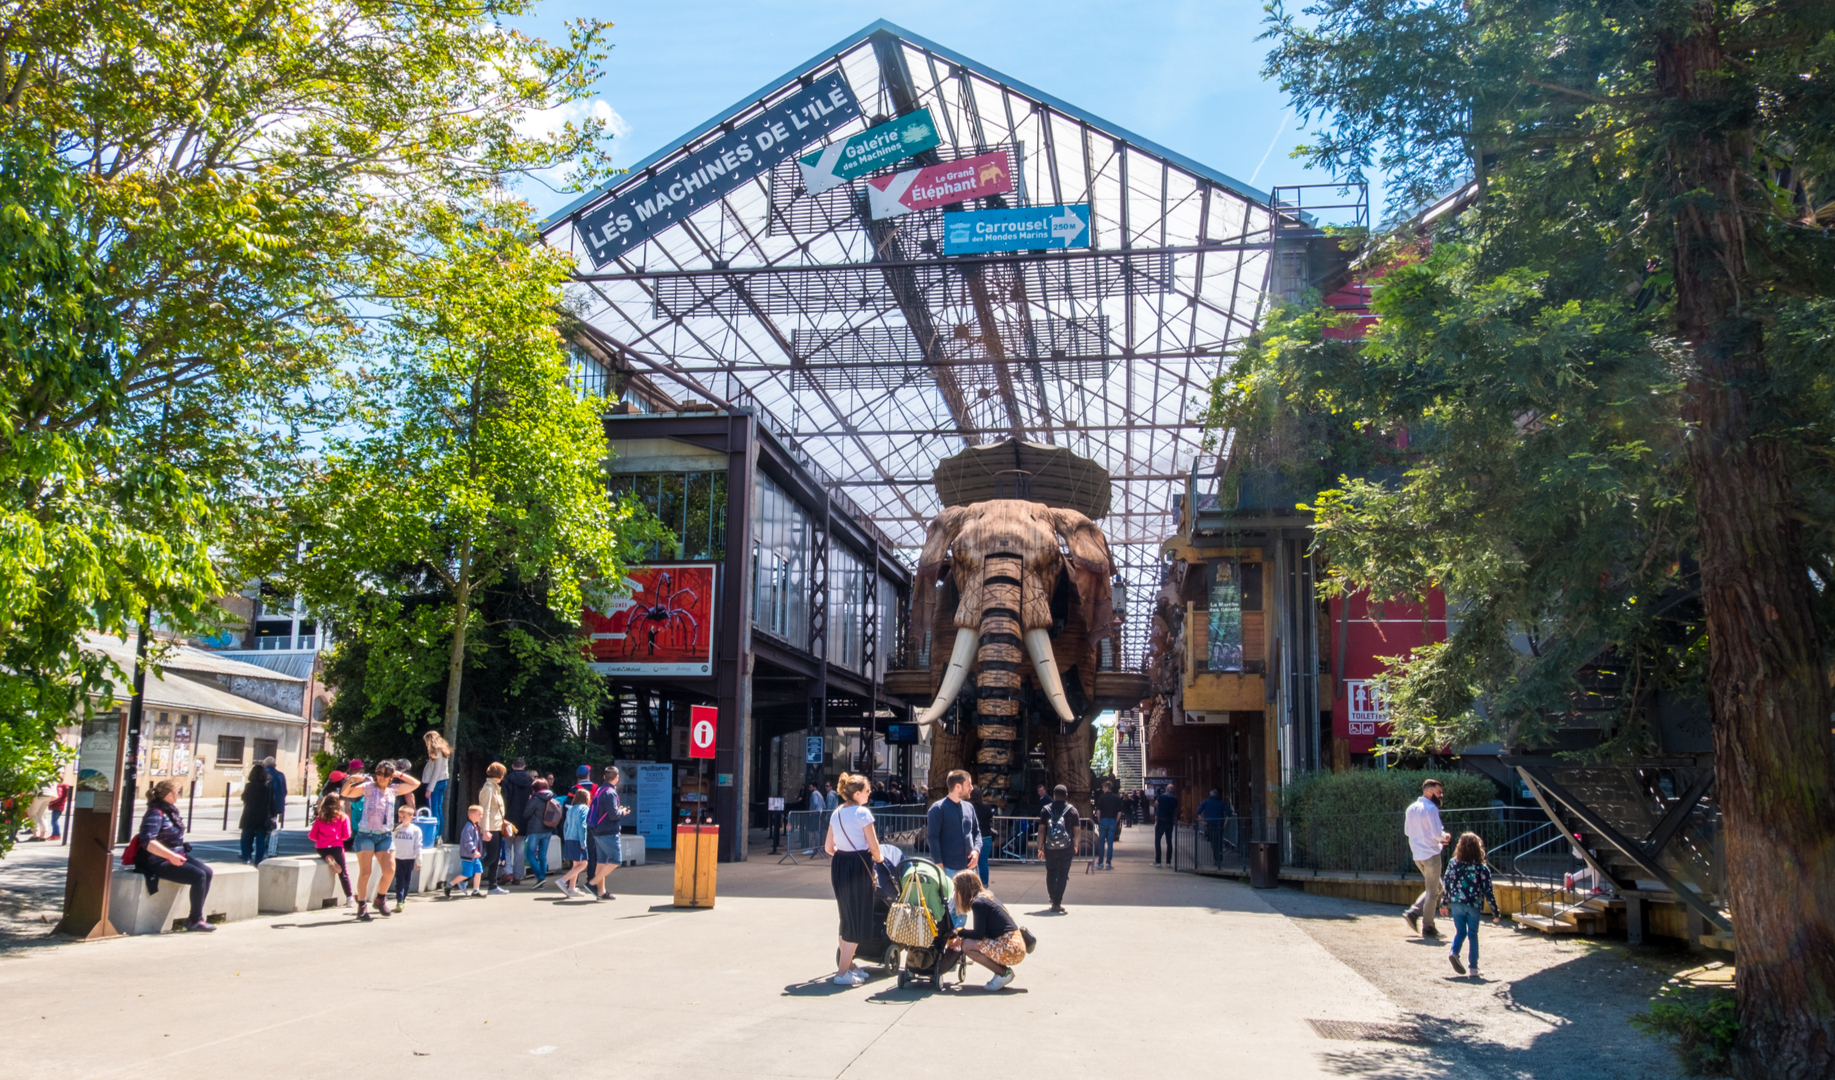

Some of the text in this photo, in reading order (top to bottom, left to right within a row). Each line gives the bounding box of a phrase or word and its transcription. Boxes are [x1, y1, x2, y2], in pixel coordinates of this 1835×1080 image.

[845, 131, 898, 158] Galerie
[843, 142, 902, 171] des Machines
[588, 213, 633, 250] LES
[635, 143, 754, 222] MACHINES
[755, 122, 790, 151] DE
[935, 168, 975, 184] Le Grand
[912, 178, 977, 201] Éléphant
[975, 219, 1048, 234] Carrousel
[986, 233, 1016, 242] Mondes
[1019, 232, 1048, 241] Marins
